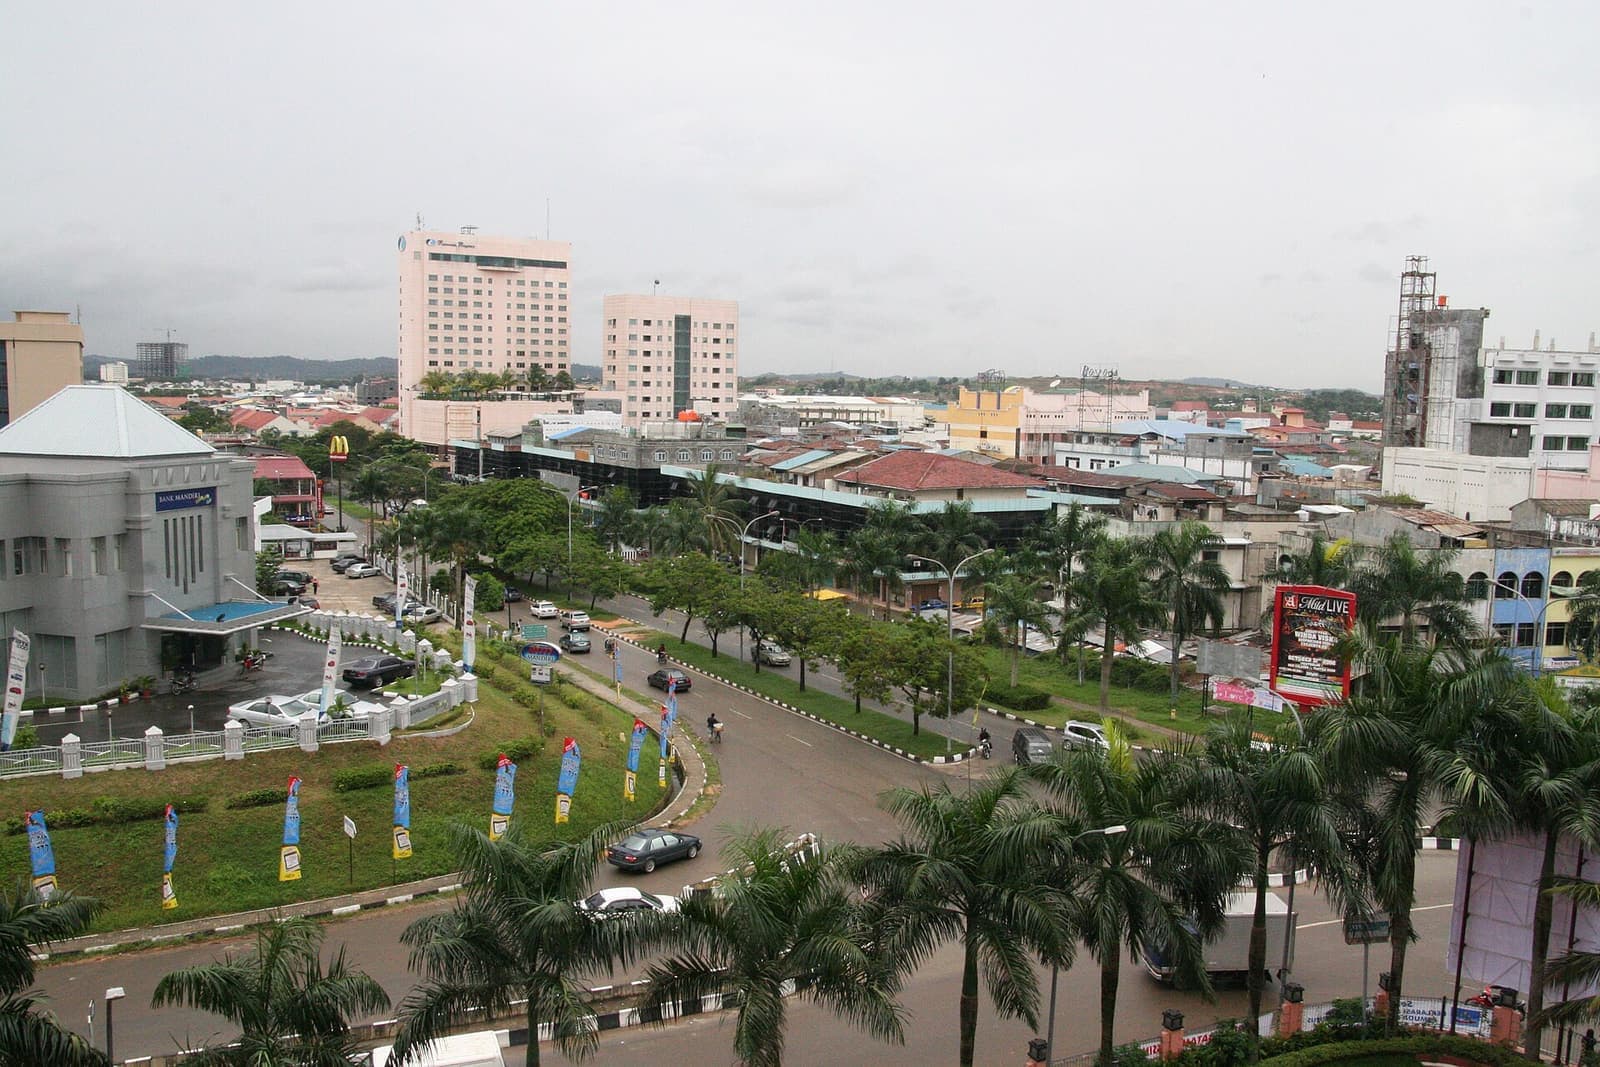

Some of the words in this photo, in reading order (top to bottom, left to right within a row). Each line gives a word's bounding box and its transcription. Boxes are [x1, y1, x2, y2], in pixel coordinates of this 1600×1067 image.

[159, 495, 175, 503] BANK
[175, 492, 201, 502] MANDIRI
[1299, 597, 1326, 610] Mild
[1327, 600, 1349, 613] LIVE
